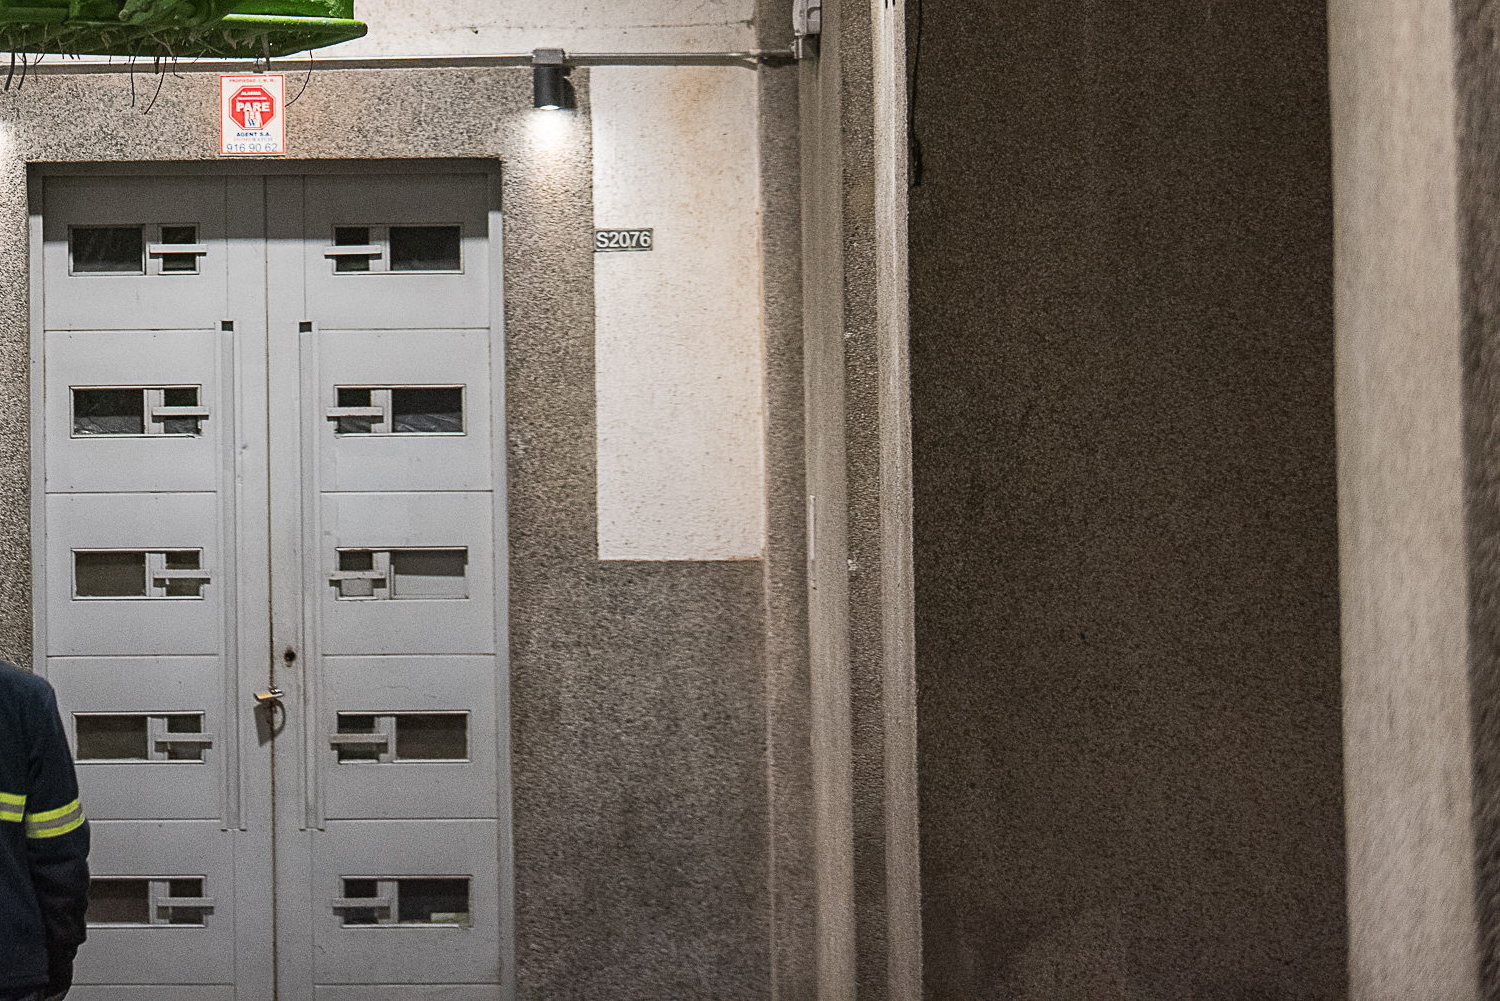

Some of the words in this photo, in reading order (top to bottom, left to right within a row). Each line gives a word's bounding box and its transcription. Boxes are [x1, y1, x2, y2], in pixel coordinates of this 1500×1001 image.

[235, 102, 271, 112] PARE
[226, 143, 246, 153] 916
[248, 143, 262, 153] 90
[264, 143, 278, 153] 62
[596, 231, 651, 248] S2076
